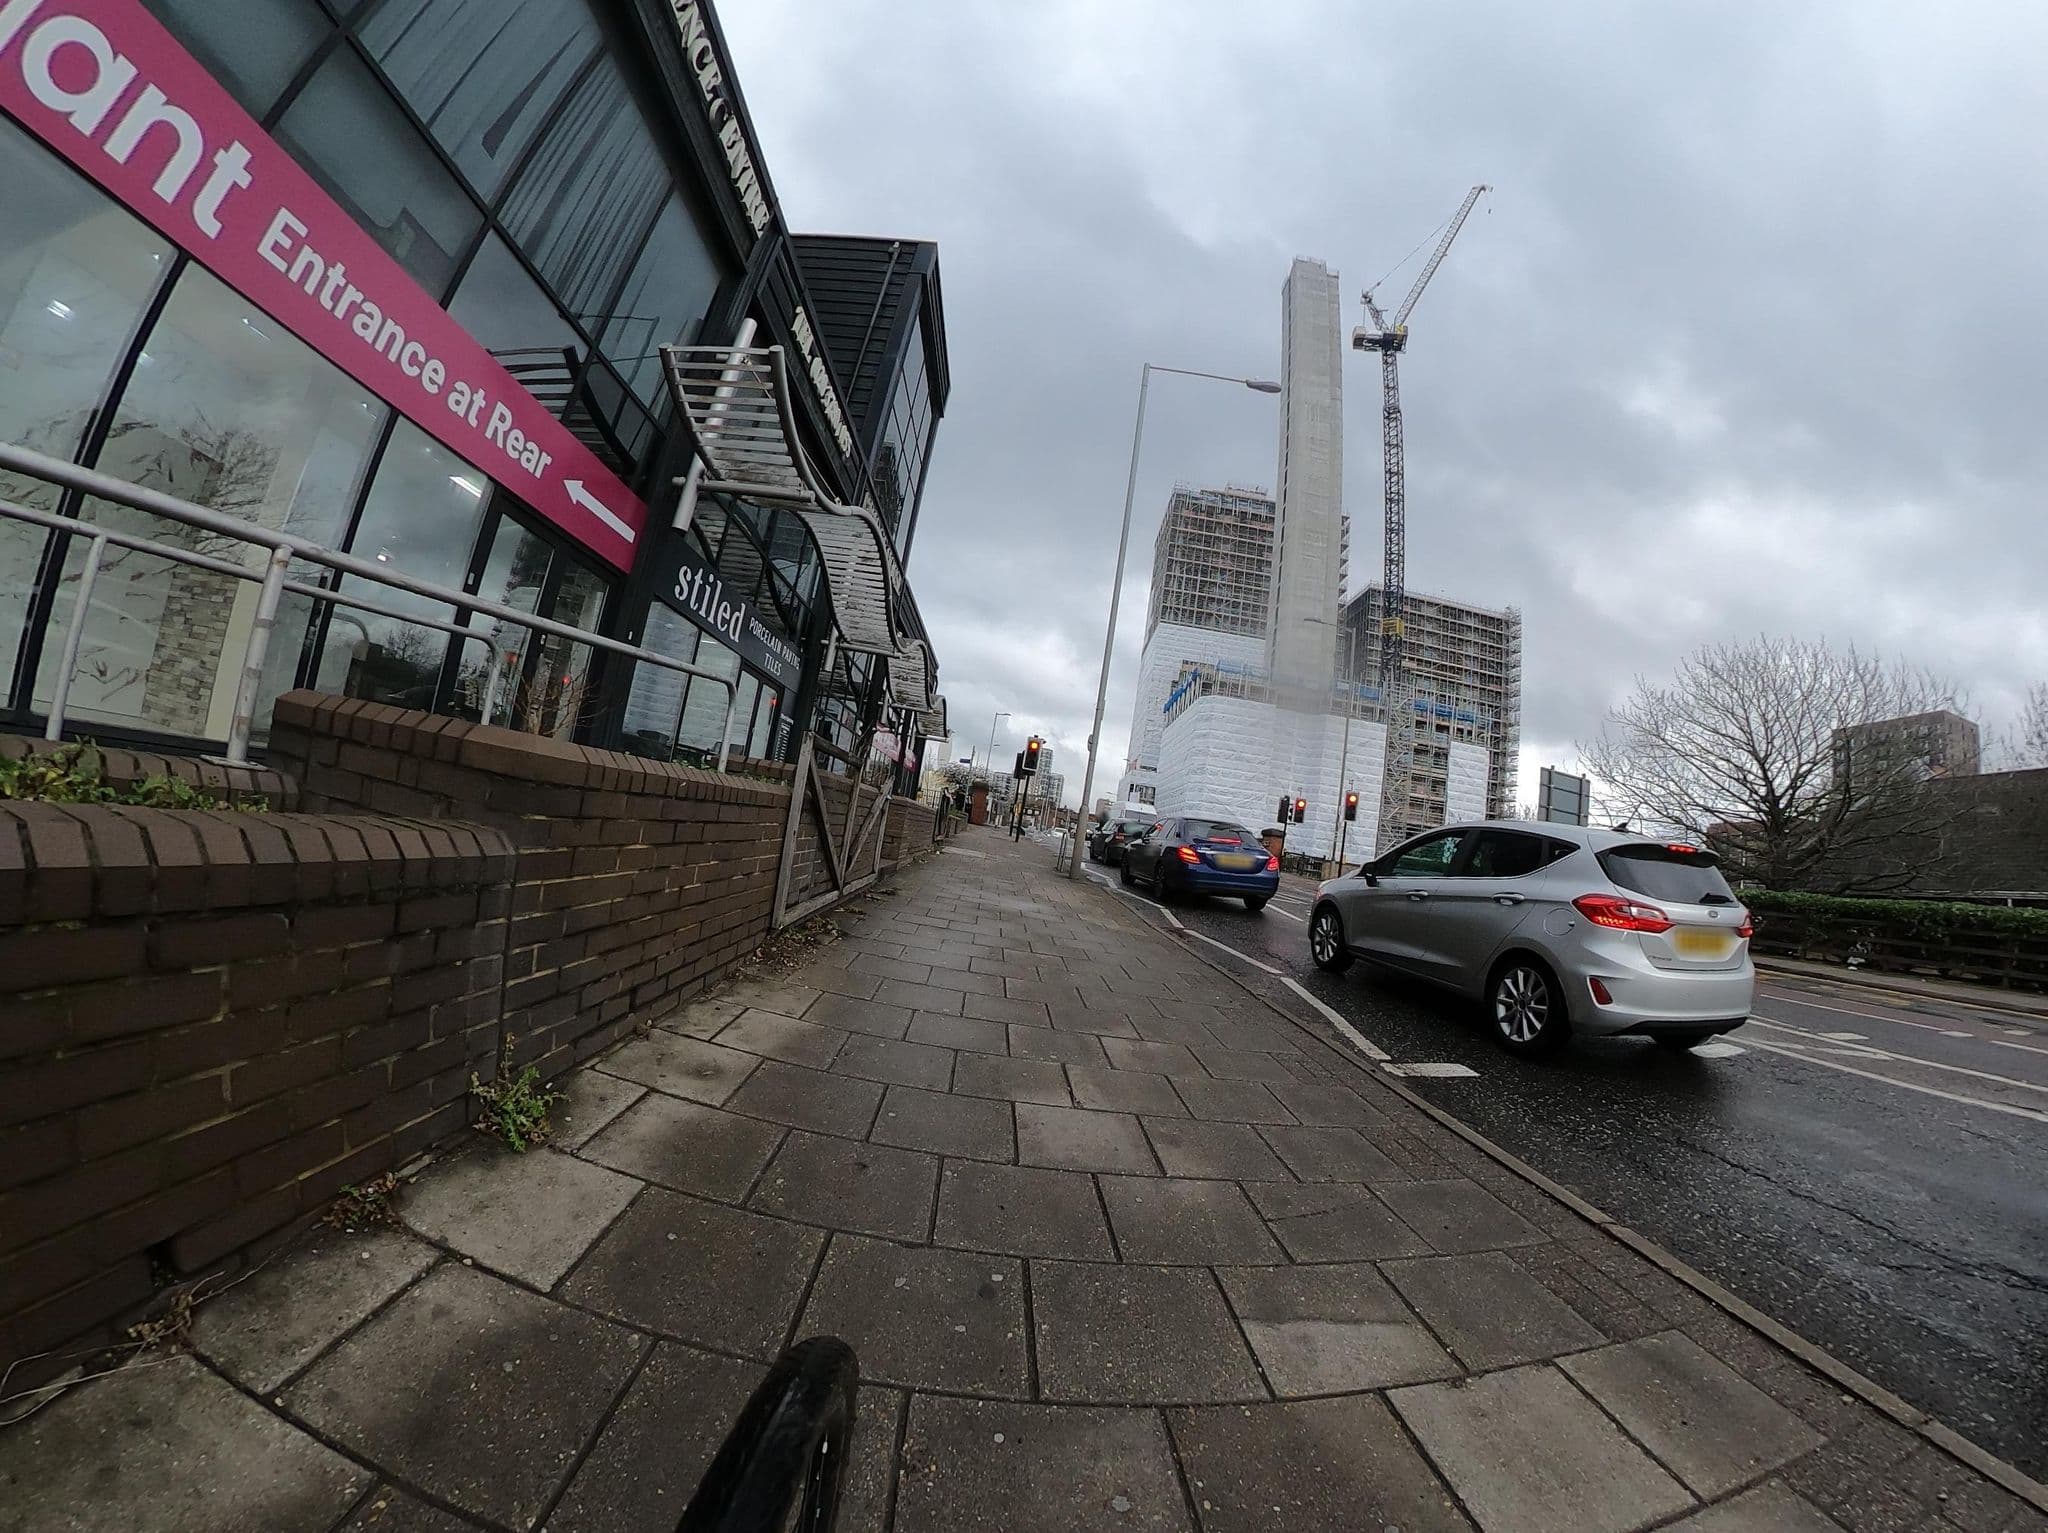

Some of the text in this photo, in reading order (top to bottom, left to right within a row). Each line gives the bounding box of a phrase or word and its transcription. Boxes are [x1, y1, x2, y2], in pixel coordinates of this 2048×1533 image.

[256, 206, 447, 395] Entrance
[447, 381, 487, 429] at
[484, 401, 553, 479] Rear
[674, 565, 746, 643] stiled
[749, 616, 782, 655] PORCELAIN
[764, 652, 782, 676] TILES
